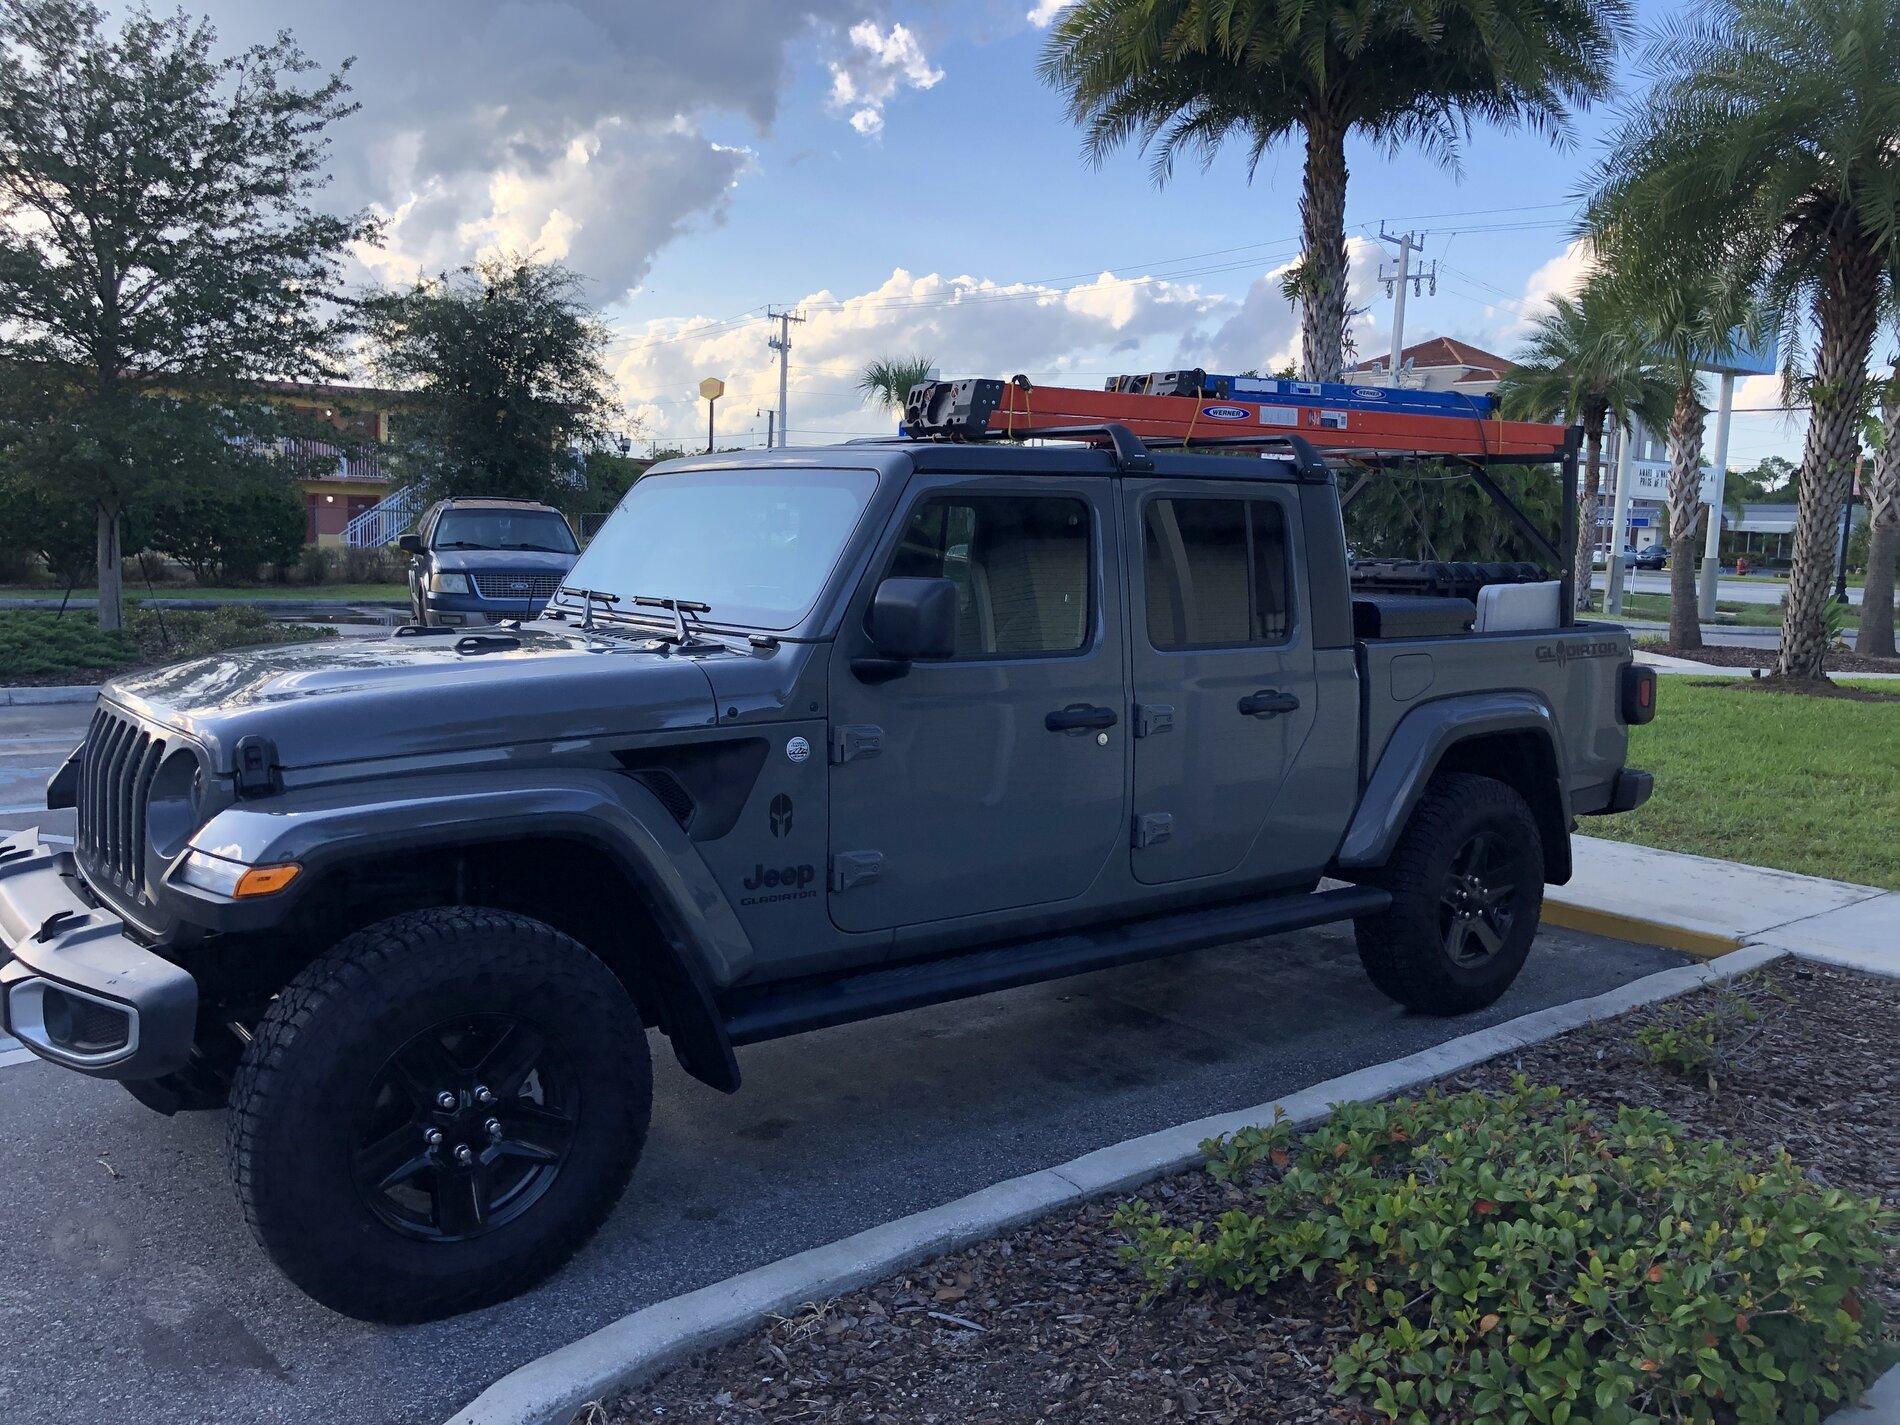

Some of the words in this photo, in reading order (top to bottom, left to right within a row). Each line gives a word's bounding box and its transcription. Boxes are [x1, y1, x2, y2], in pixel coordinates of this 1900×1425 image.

[1357, 389, 1380, 397] WERNER
[1211, 409, 1241, 417] WERNER
[743, 863, 815, 890] Jeep
[740, 889, 817, 906] GLADIATOR
